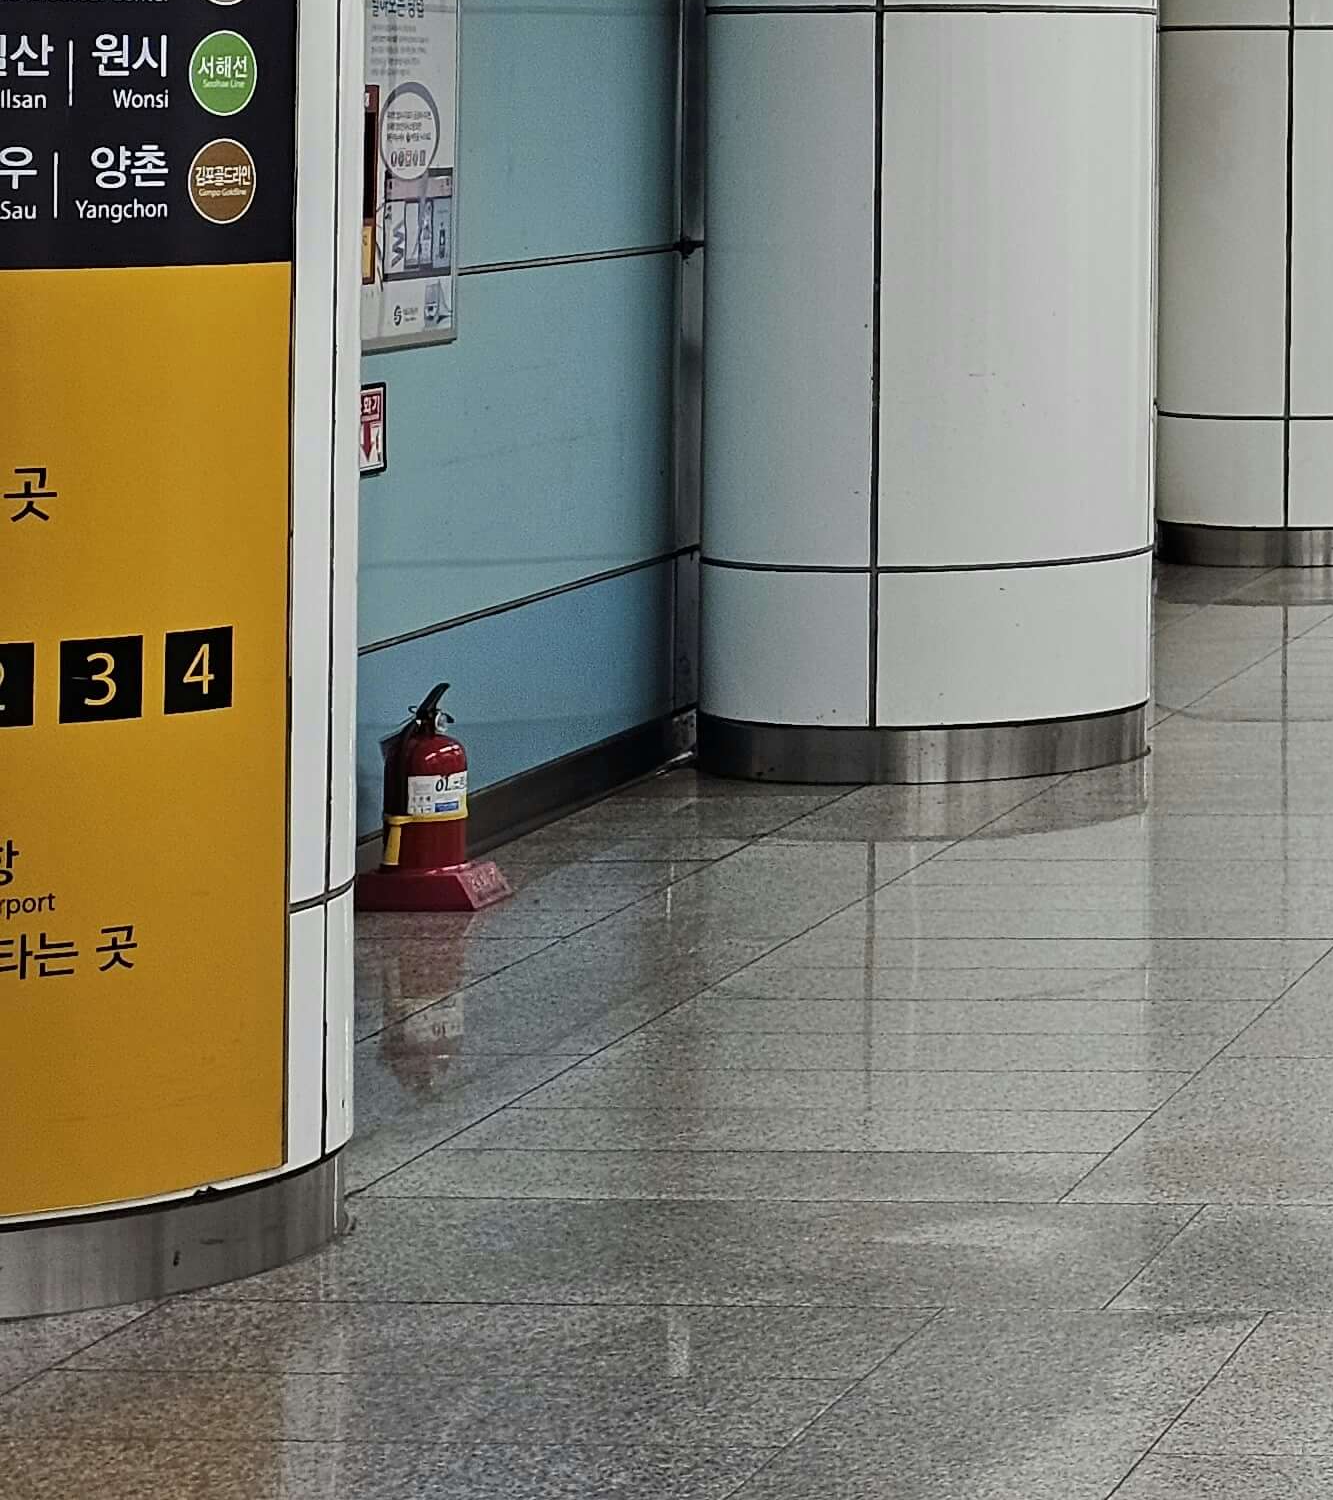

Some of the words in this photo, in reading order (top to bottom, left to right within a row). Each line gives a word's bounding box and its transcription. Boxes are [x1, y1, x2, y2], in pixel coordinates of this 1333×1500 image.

[0, 33, 54, 77] 산
[91, 33, 168, 78] 원시
[197, 55, 249, 79] 서해선
[112, 88, 169, 109] Wonsi
[90, 144, 169, 189] 양촌
[195, 165, 251, 186] 김포골드라인
[0, 200, 37, 220] Sau
[75, 198, 168, 224] Yangchon
[3, 467, 58, 523] 곳
[84, 651, 118, 707] 3
[181, 642, 216, 696] 4
[95, 925, 138, 972] 곳
